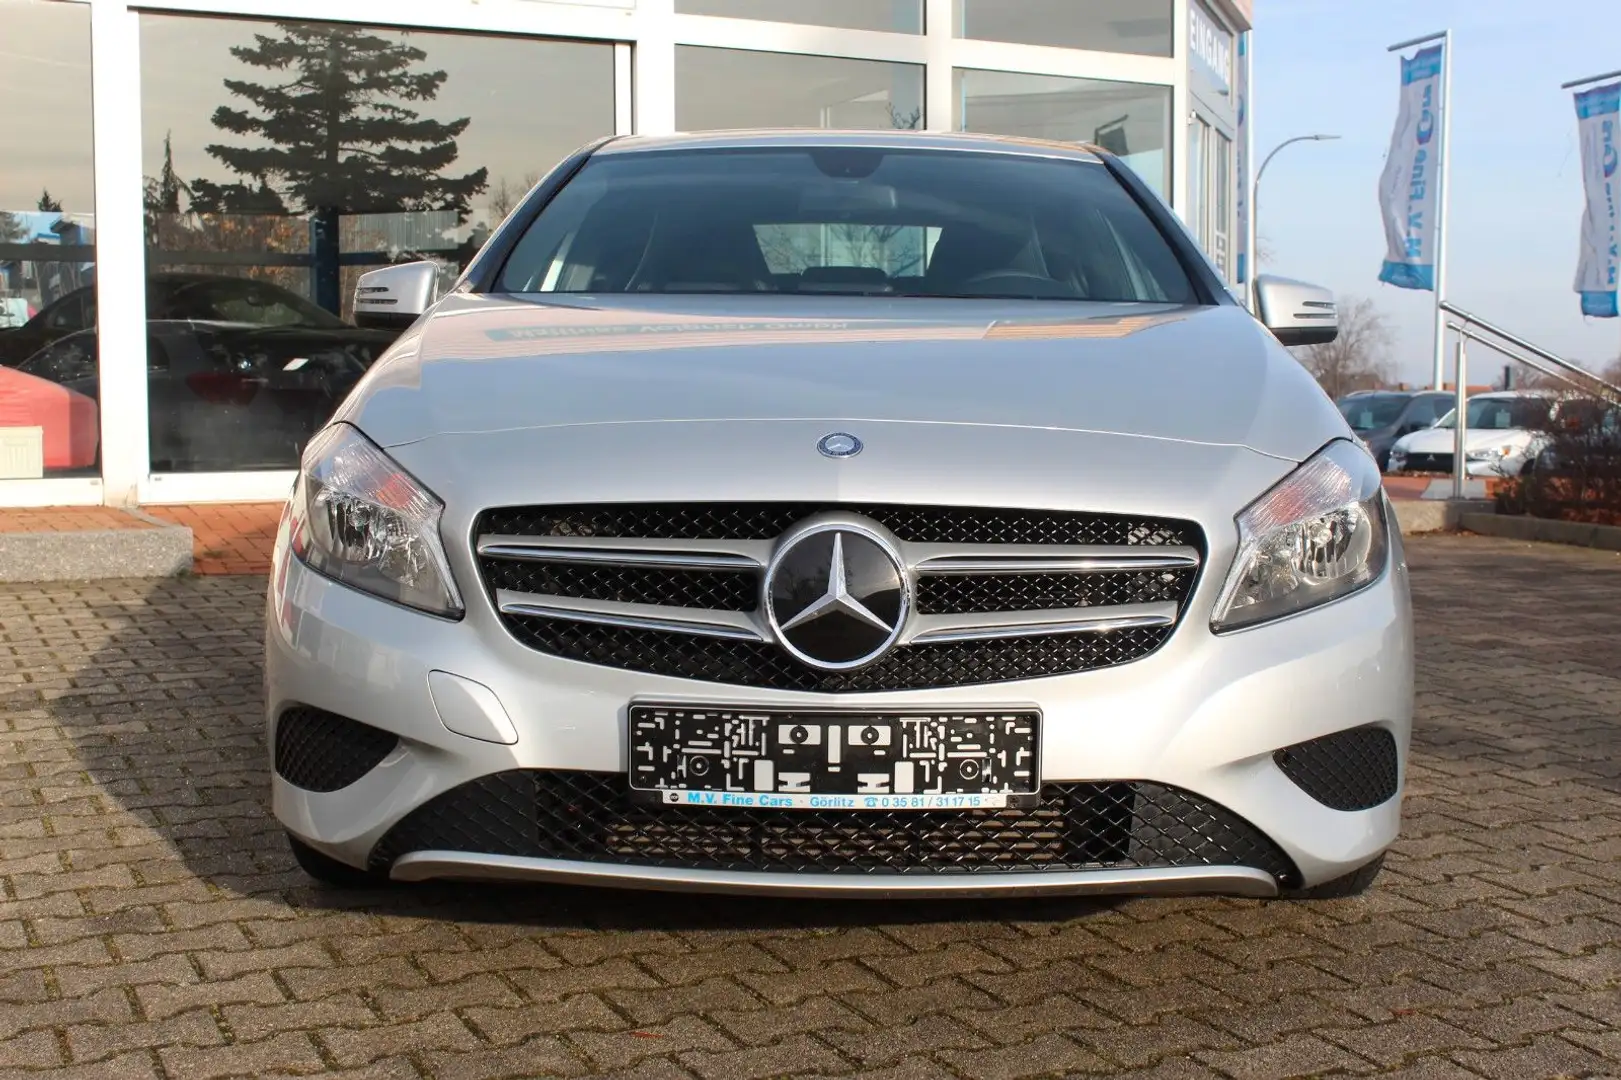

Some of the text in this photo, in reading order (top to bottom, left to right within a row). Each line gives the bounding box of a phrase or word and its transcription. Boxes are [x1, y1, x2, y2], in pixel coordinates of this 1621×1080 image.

[687, 792, 717, 804] M.V.
[722, 793, 754, 805] Fine
[759, 795, 793, 807] Cars
[810, 796, 855, 808] Görlitz
[892, 796, 907, 808] 35
[911, 796, 924, 808] 81
